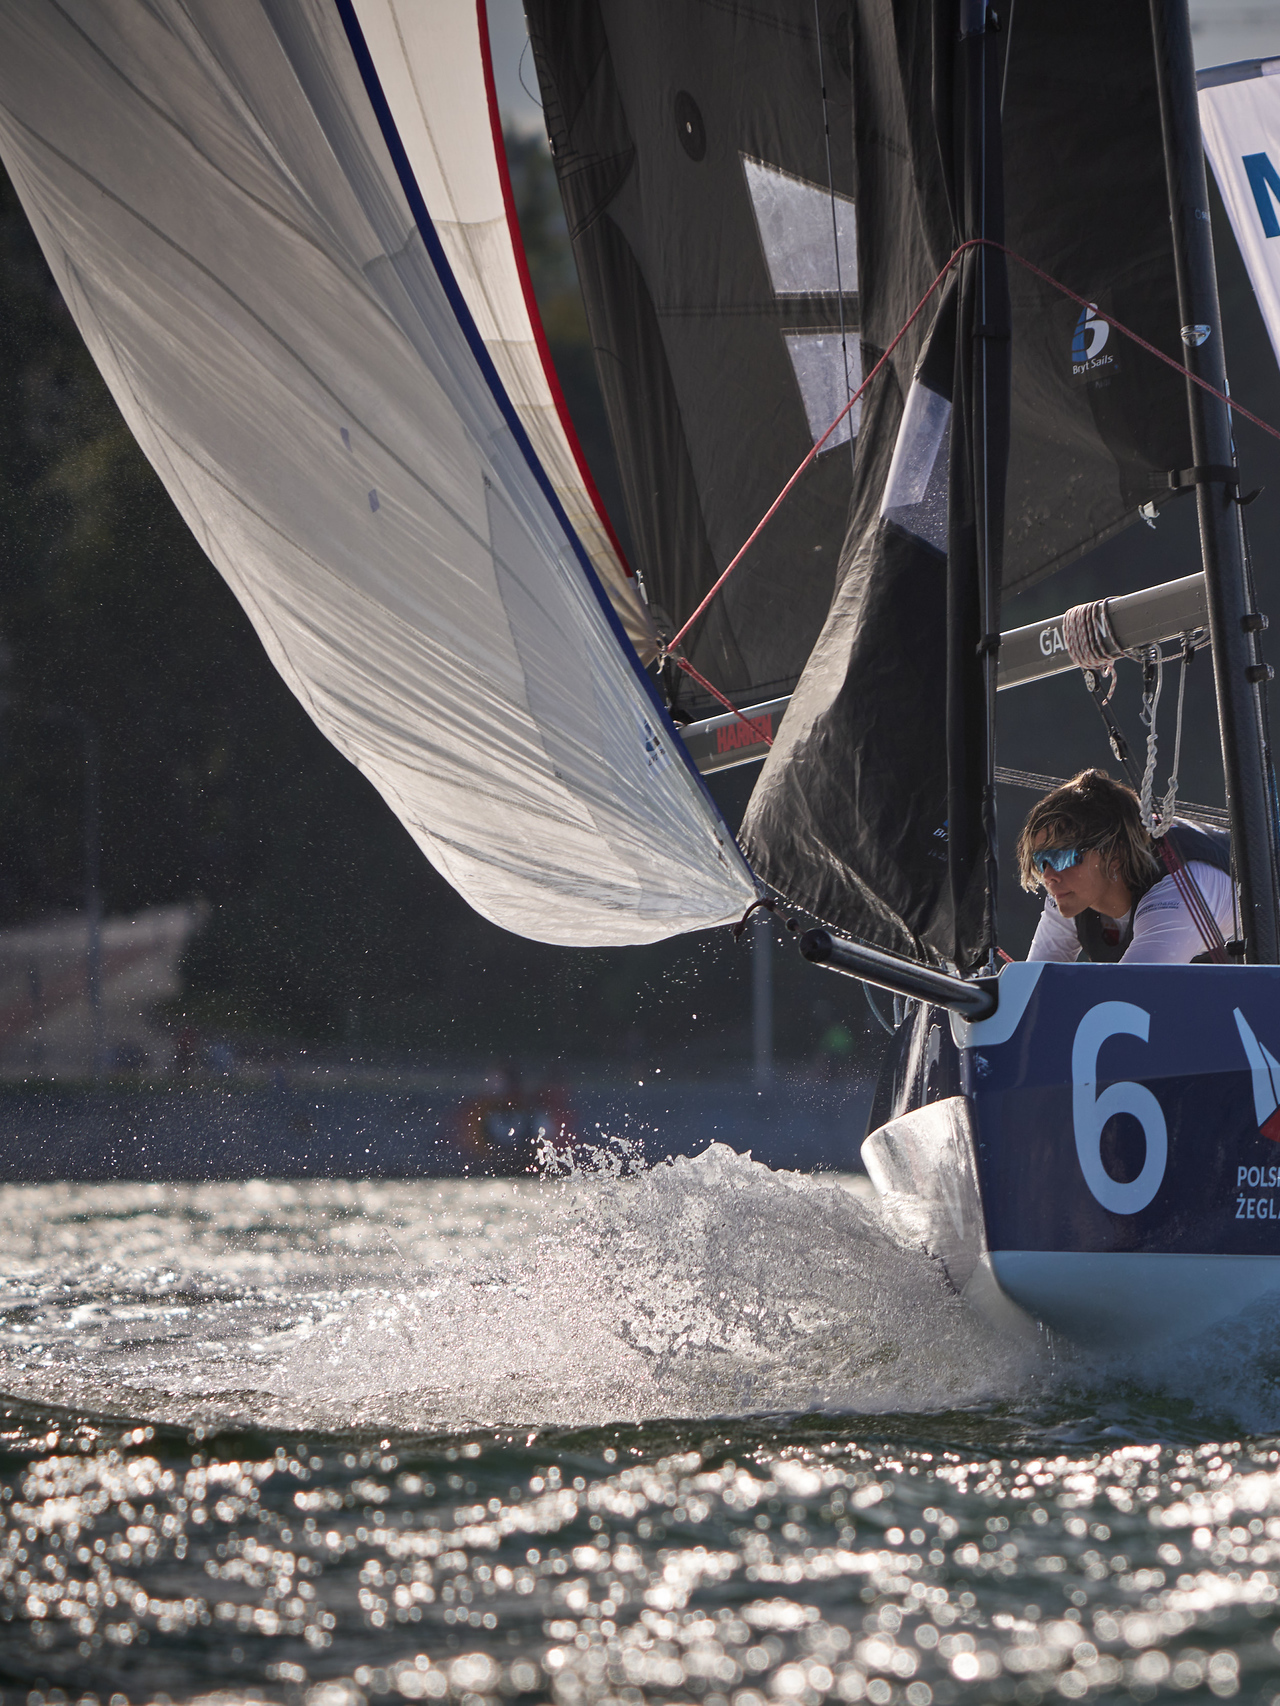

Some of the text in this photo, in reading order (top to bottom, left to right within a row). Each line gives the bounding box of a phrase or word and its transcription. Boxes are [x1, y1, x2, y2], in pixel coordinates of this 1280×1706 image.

[1072, 354, 1114, 375] Bryt Sails
[717, 713, 773, 754] HARKEN
[1071, 1001, 1168, 1215] 6
